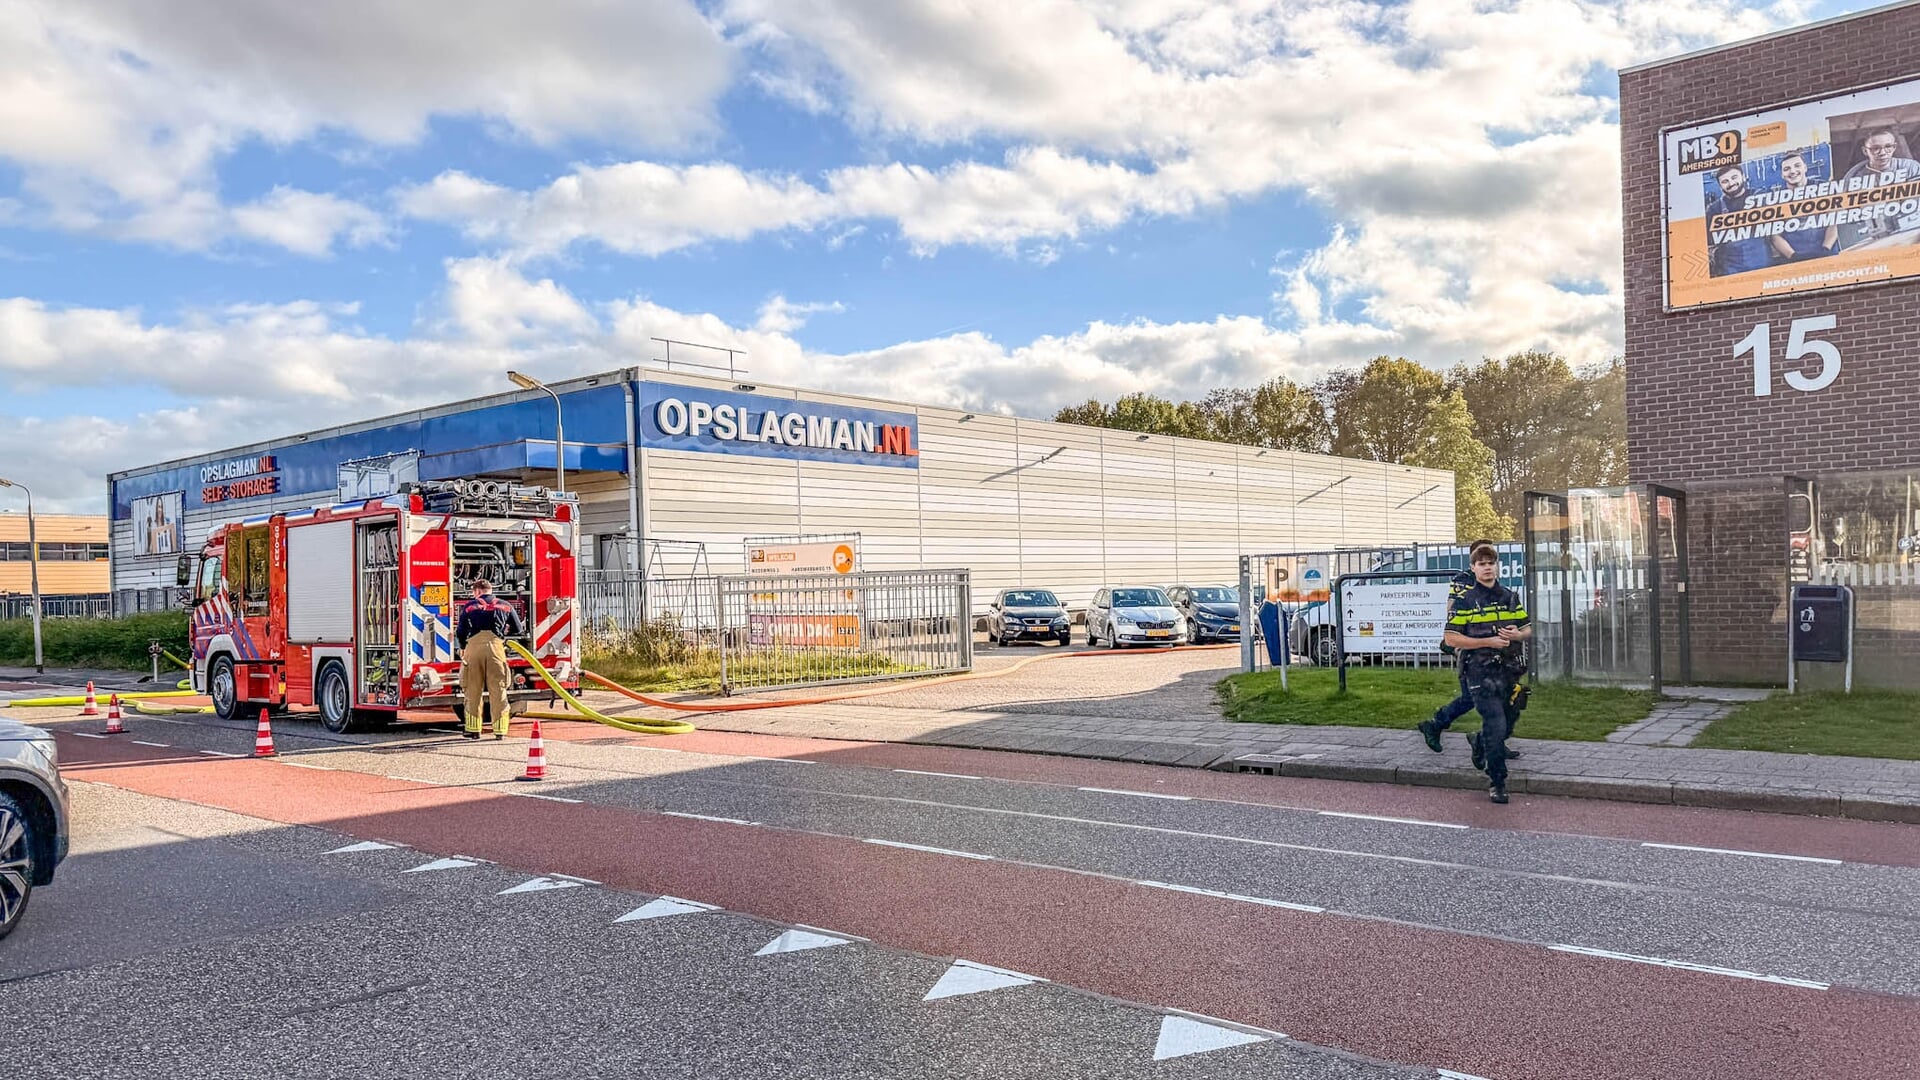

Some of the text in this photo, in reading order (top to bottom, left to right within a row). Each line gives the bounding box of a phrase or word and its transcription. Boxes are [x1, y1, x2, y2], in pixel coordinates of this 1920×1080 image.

[1681, 132, 1738, 163] MBO
[1681, 155, 1738, 173] AMERSFOORT
[1743, 169, 1908, 210] STUDEREN BIJ DE
[1712, 181, 1920, 229] SCHOOL VOOR TECHNI
[1711, 199, 1920, 246] VAN MBO AMERSFOO
[1762, 265, 1890, 290] MBOAMERSFOORT.NL
[1733, 314, 1842, 397] 15
[658, 398, 919, 456] OPSLAGMAN.NL
[200, 456, 275, 483] OPSLAGMAN.NL
[1275, 568, 1288, 589] P
[1380, 591, 1430, 599] PARKEERTERREIN
[1381, 609, 1432, 617] FIETSENSTALLING
